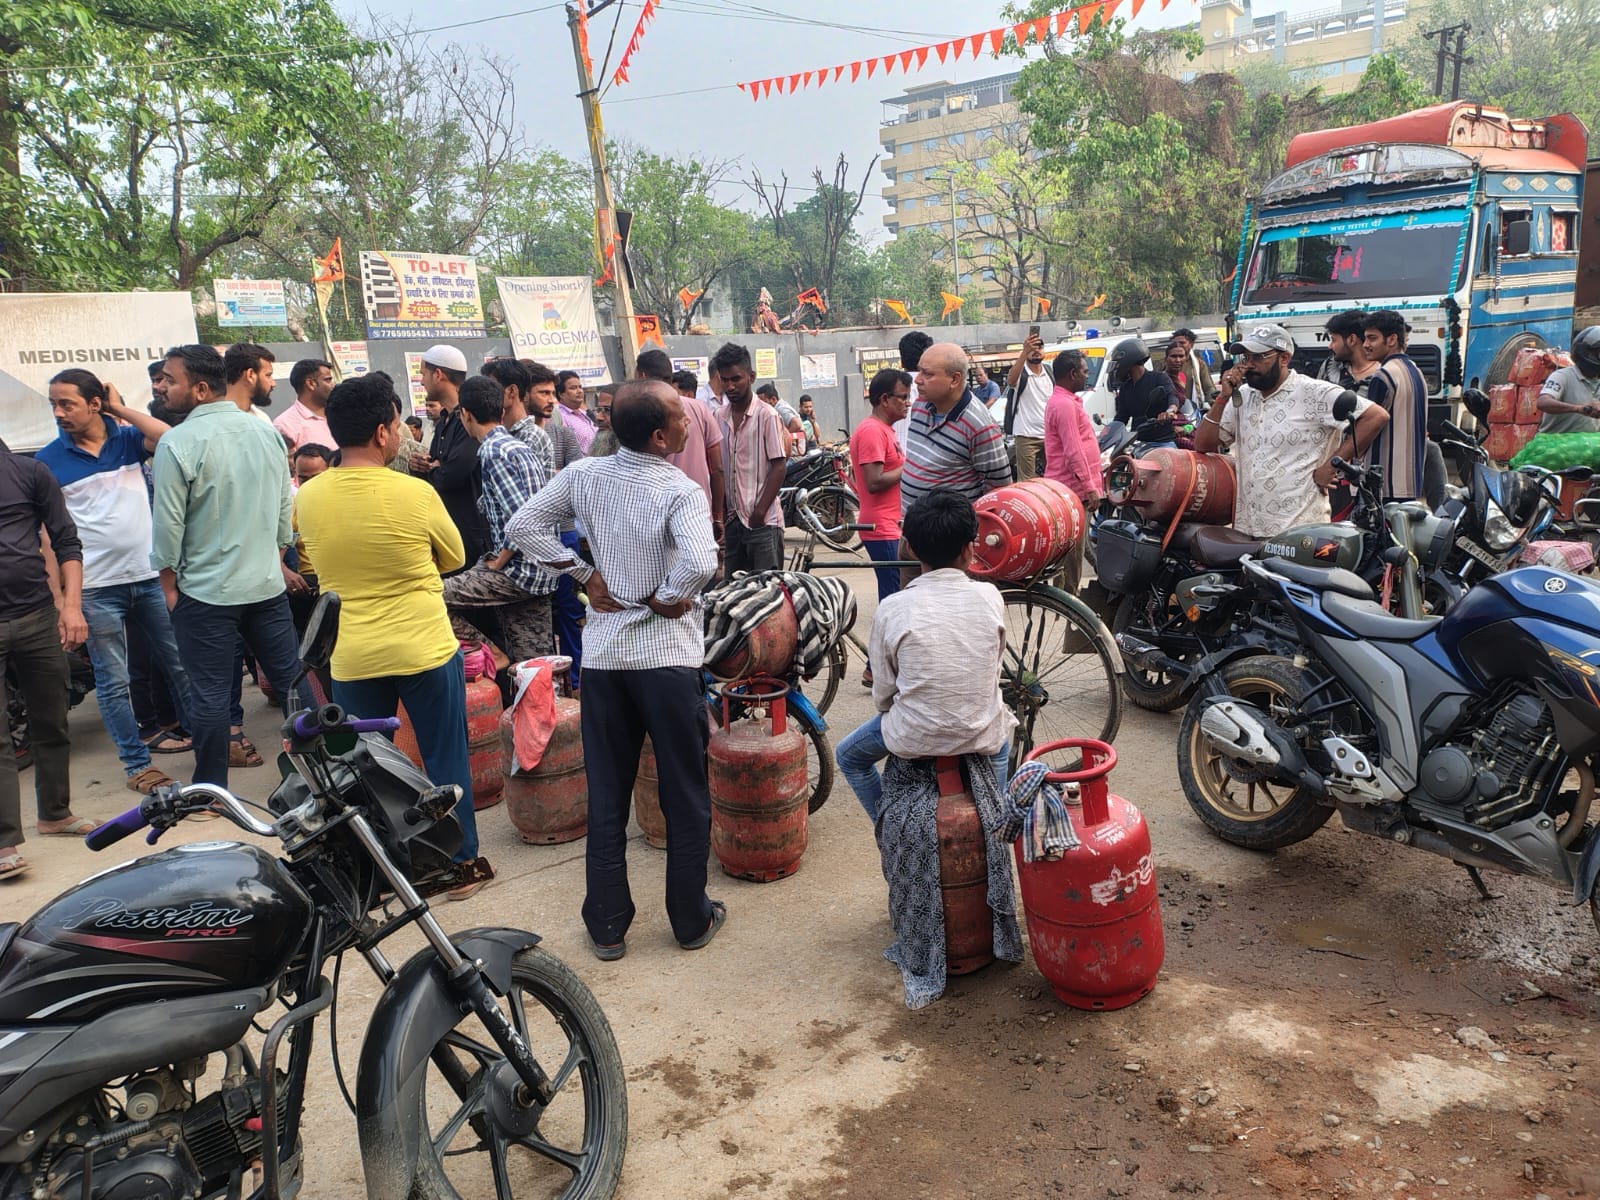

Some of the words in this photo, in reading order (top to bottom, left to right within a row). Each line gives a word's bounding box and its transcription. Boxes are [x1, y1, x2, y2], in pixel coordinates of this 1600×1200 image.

[407, 259, 467, 275] TO-LET
[504, 281, 550, 295] Opening
[551, 279, 586, 292] Shortly
[515, 332, 537, 347] GD
[540, 330, 598, 346] GOENKA
[19, 347, 140, 365] MEDISINEN
[60, 895, 255, 930] Passion
[164, 927, 238, 937] PRO
